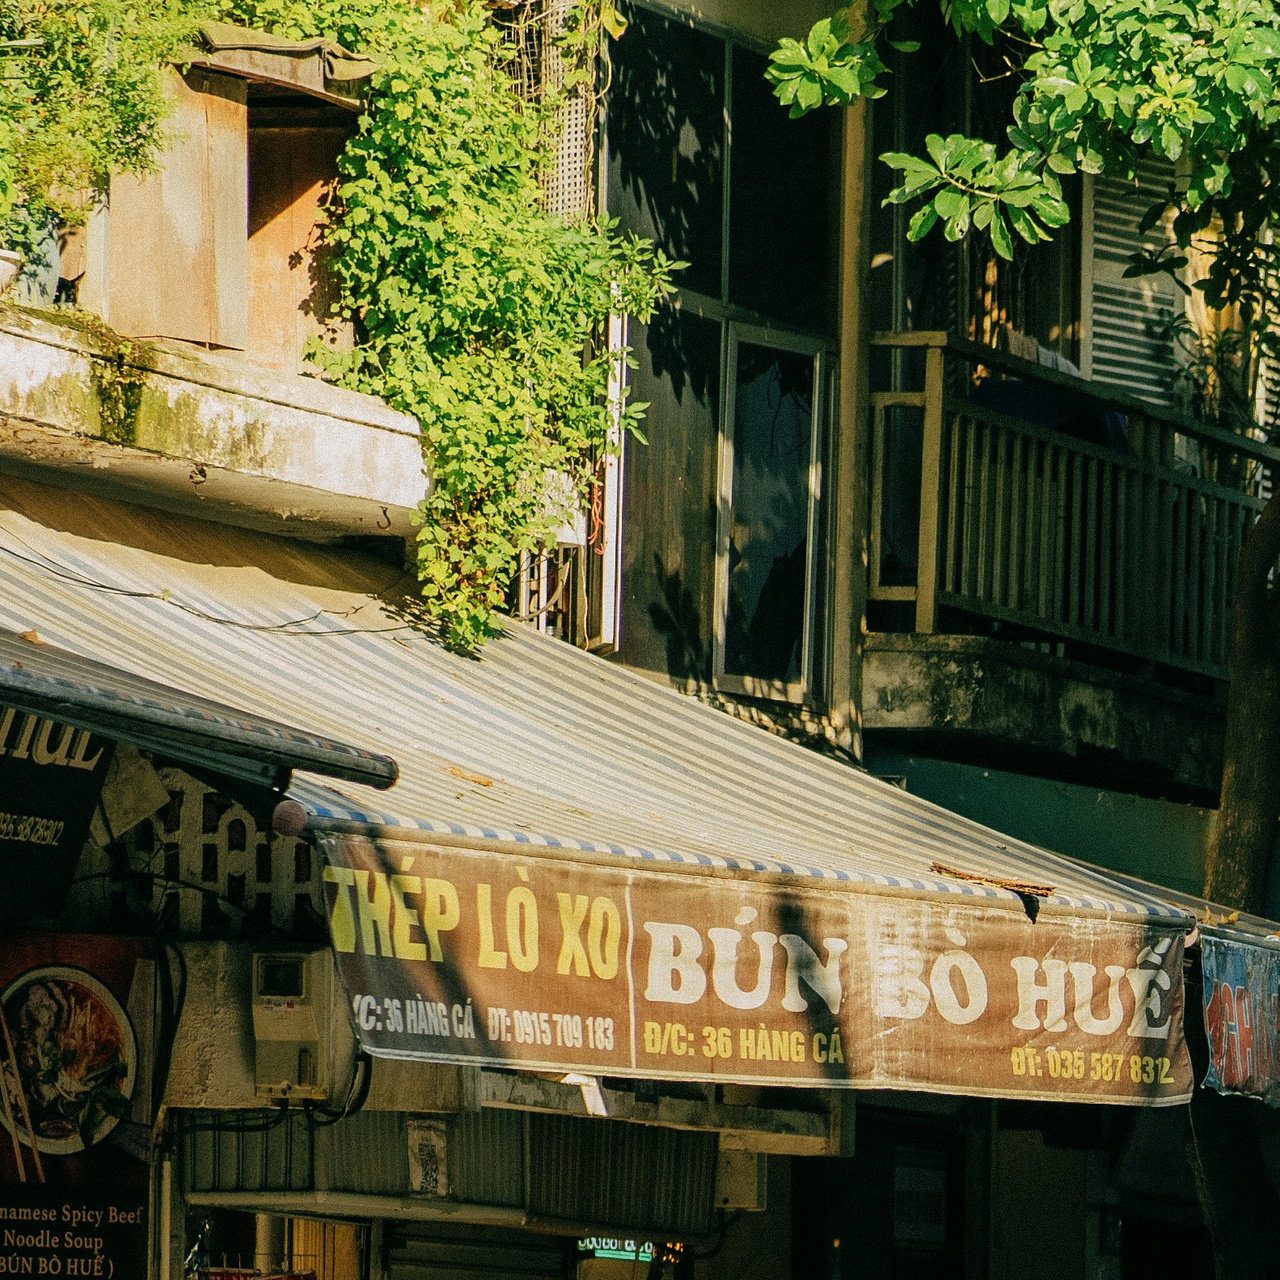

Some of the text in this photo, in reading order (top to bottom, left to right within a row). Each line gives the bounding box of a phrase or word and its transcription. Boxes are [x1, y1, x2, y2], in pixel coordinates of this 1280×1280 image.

[323, 857, 622, 981] THÉP LÒ XO
[643, 906, 1172, 1041] BÚN BÒ HUẾ
[353, 991, 615, 1052] /C: 36 HÀNG CÁ ĐT: 0915 709 183
[643, 1018, 846, 1065] Đ/C: 36 HÀNG CÁ
[1011, 1046, 1174, 1086] ĐT: 035 587 8312
[62, 1205, 104, 1227] Spicy
[109, 1207, 143, 1224] Beef
[4, 1230, 104, 1254] Noodle Soup
[38, 1254, 61, 1275] BÒ
